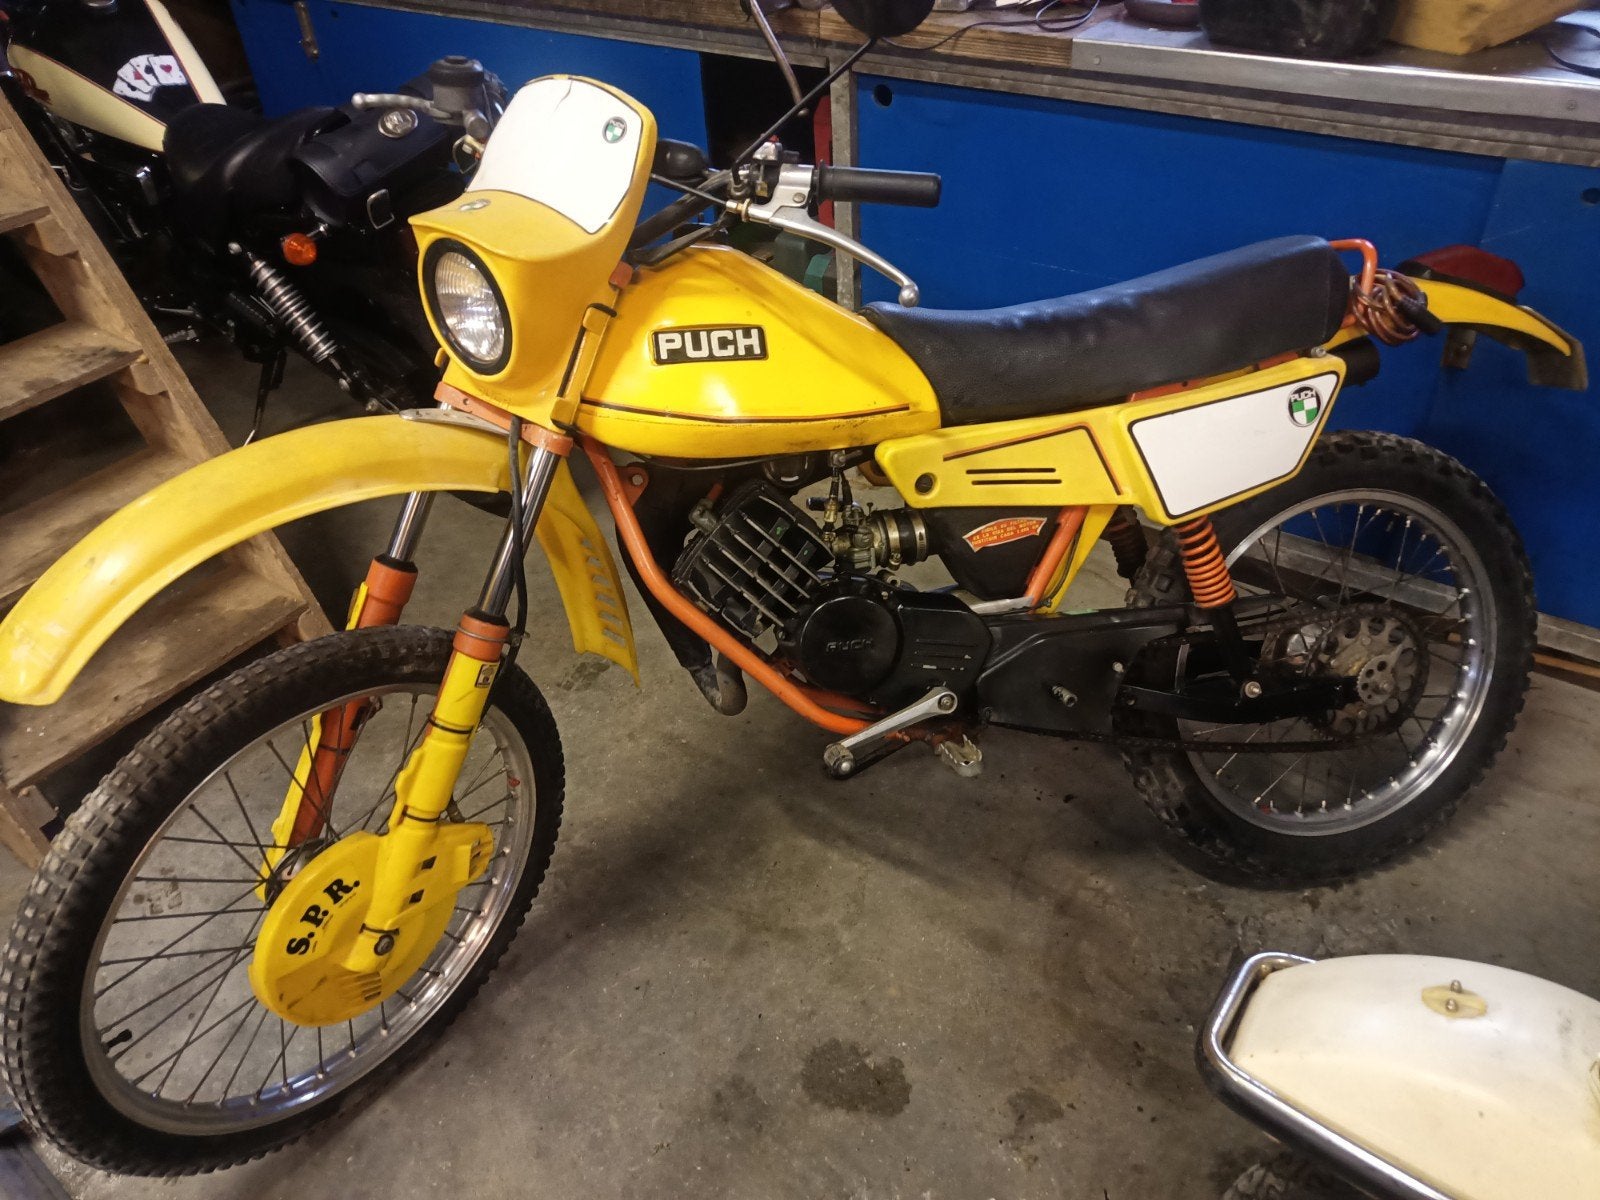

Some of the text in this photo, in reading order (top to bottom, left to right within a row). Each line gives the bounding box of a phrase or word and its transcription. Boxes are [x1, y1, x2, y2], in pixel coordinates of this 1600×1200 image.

[658, 328, 761, 360] PUCH
[1290, 389, 1317, 402] PUCH
[826, 638, 873, 652] PUCH
